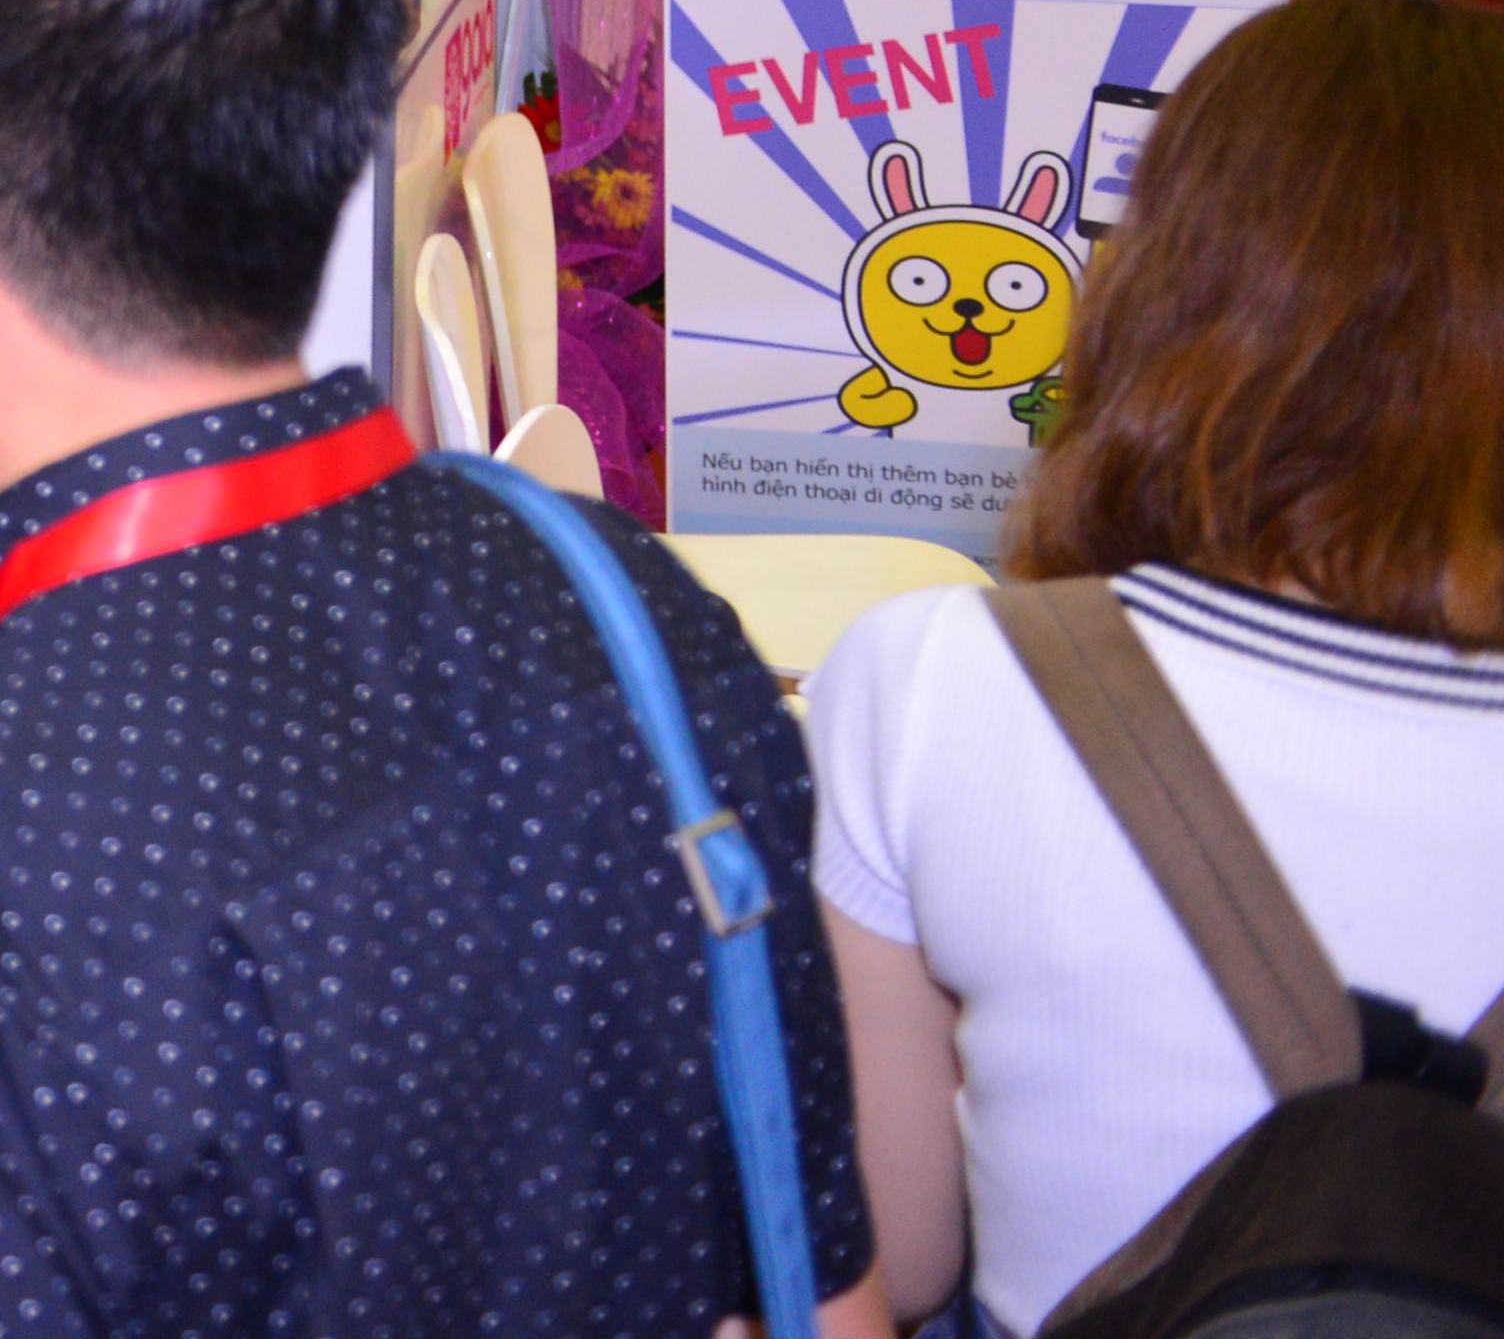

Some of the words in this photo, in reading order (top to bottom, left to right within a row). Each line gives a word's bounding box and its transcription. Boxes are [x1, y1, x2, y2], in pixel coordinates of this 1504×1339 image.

[707, 23, 1002, 137] EVENT
[750, 455, 788, 475] bạn
[847, 461, 875, 482] thị
[882, 463, 937, 485] thêm
[944, 468, 985, 490] bạn
[992, 471, 1018, 491] bè
[701, 475, 747, 495] hình
[753, 478, 798, 500] điện
[804, 482, 857, 503] thoại
[864, 485, 883, 505] di
[890, 487, 944, 512] động
[950, 492, 975, 512] sẽ
